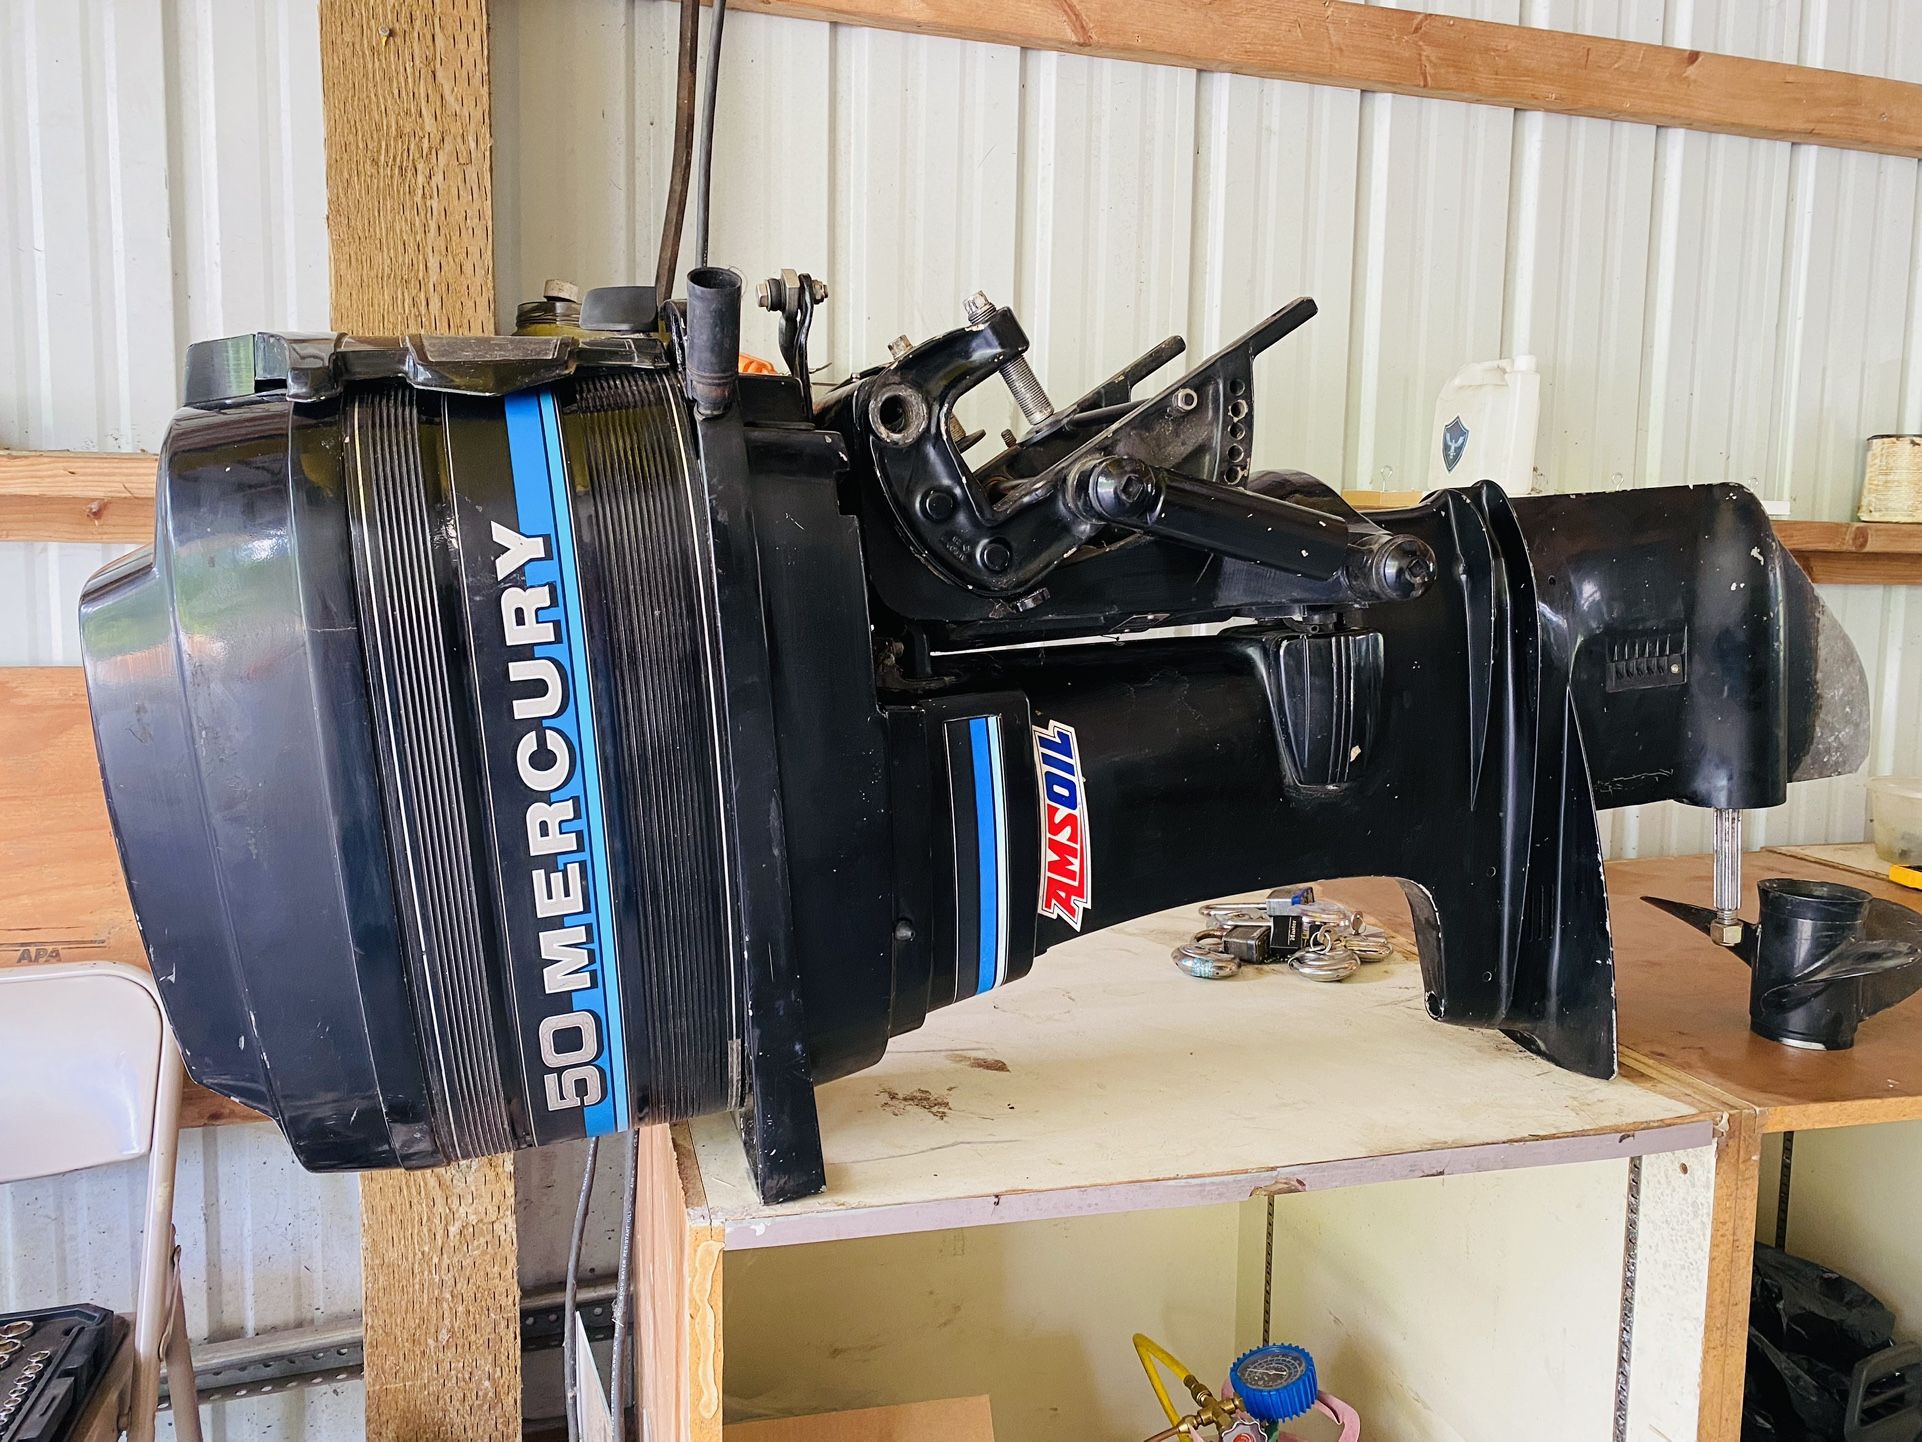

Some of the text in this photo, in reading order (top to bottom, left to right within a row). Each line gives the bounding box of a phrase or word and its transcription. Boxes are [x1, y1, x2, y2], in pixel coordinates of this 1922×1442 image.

[490, 520, 604, 1112] 50 MERCURY
[1038, 730, 1085, 919] AMSOIL
[16, 947, 62, 964] APA
[622, 1226, 631, 1258] RESISTANT
